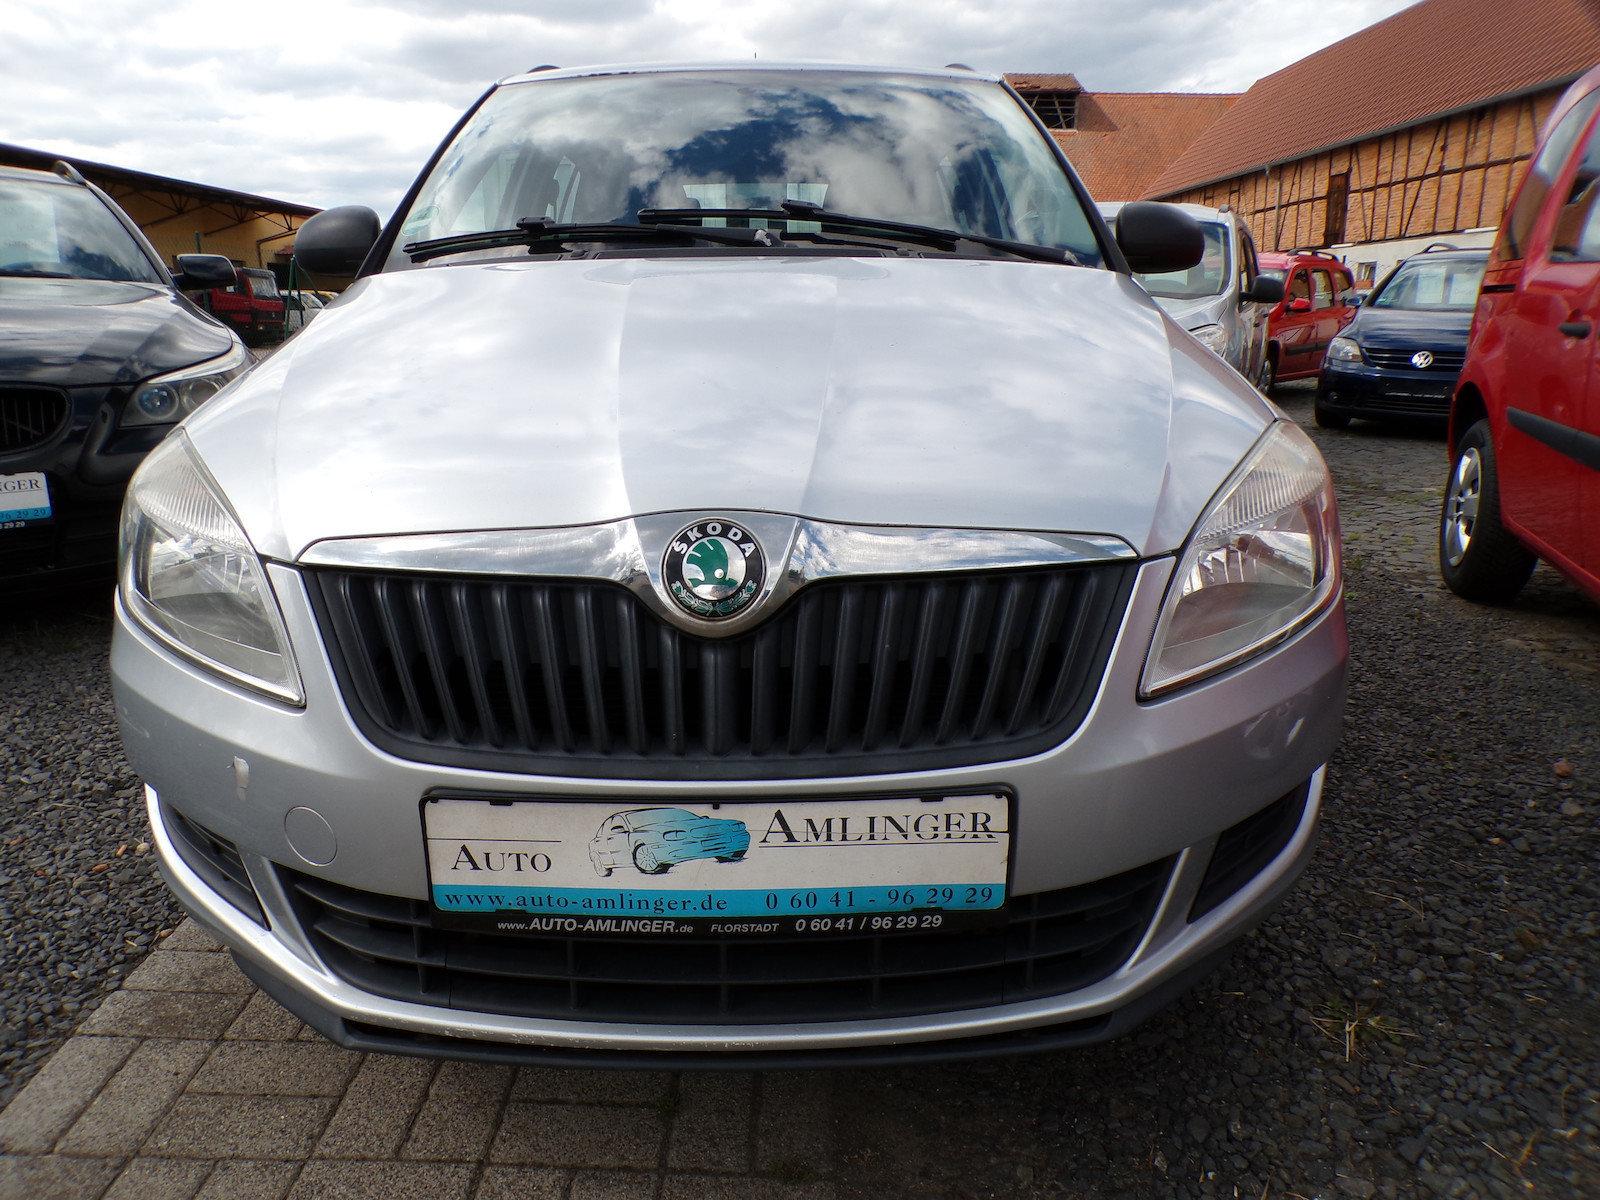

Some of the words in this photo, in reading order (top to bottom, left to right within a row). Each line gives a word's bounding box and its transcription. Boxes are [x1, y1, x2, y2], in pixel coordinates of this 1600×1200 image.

[0, 479, 41, 491] GER
[451, 844, 552, 873] AUTO
[759, 809, 996, 844] AMLINGER
[445, 893, 728, 914] www.auto-amlinger.de
[790, 891, 818, 909] 60
[829, 889, 856, 908] 41
[887, 888, 915, 906] 96
[926, 886, 954, 904] 29
[965, 886, 993, 904] 29
[497, 917, 694, 933] www.AUTO-AMLINGER.de
[710, 922, 780, 933] FLORSTADT
[810, 917, 832, 931] 60
[834, 917, 854, 931] 41
[871, 916, 893, 930] 96
[896, 915, 918, 930] 29
[920, 914, 943, 928] 29
